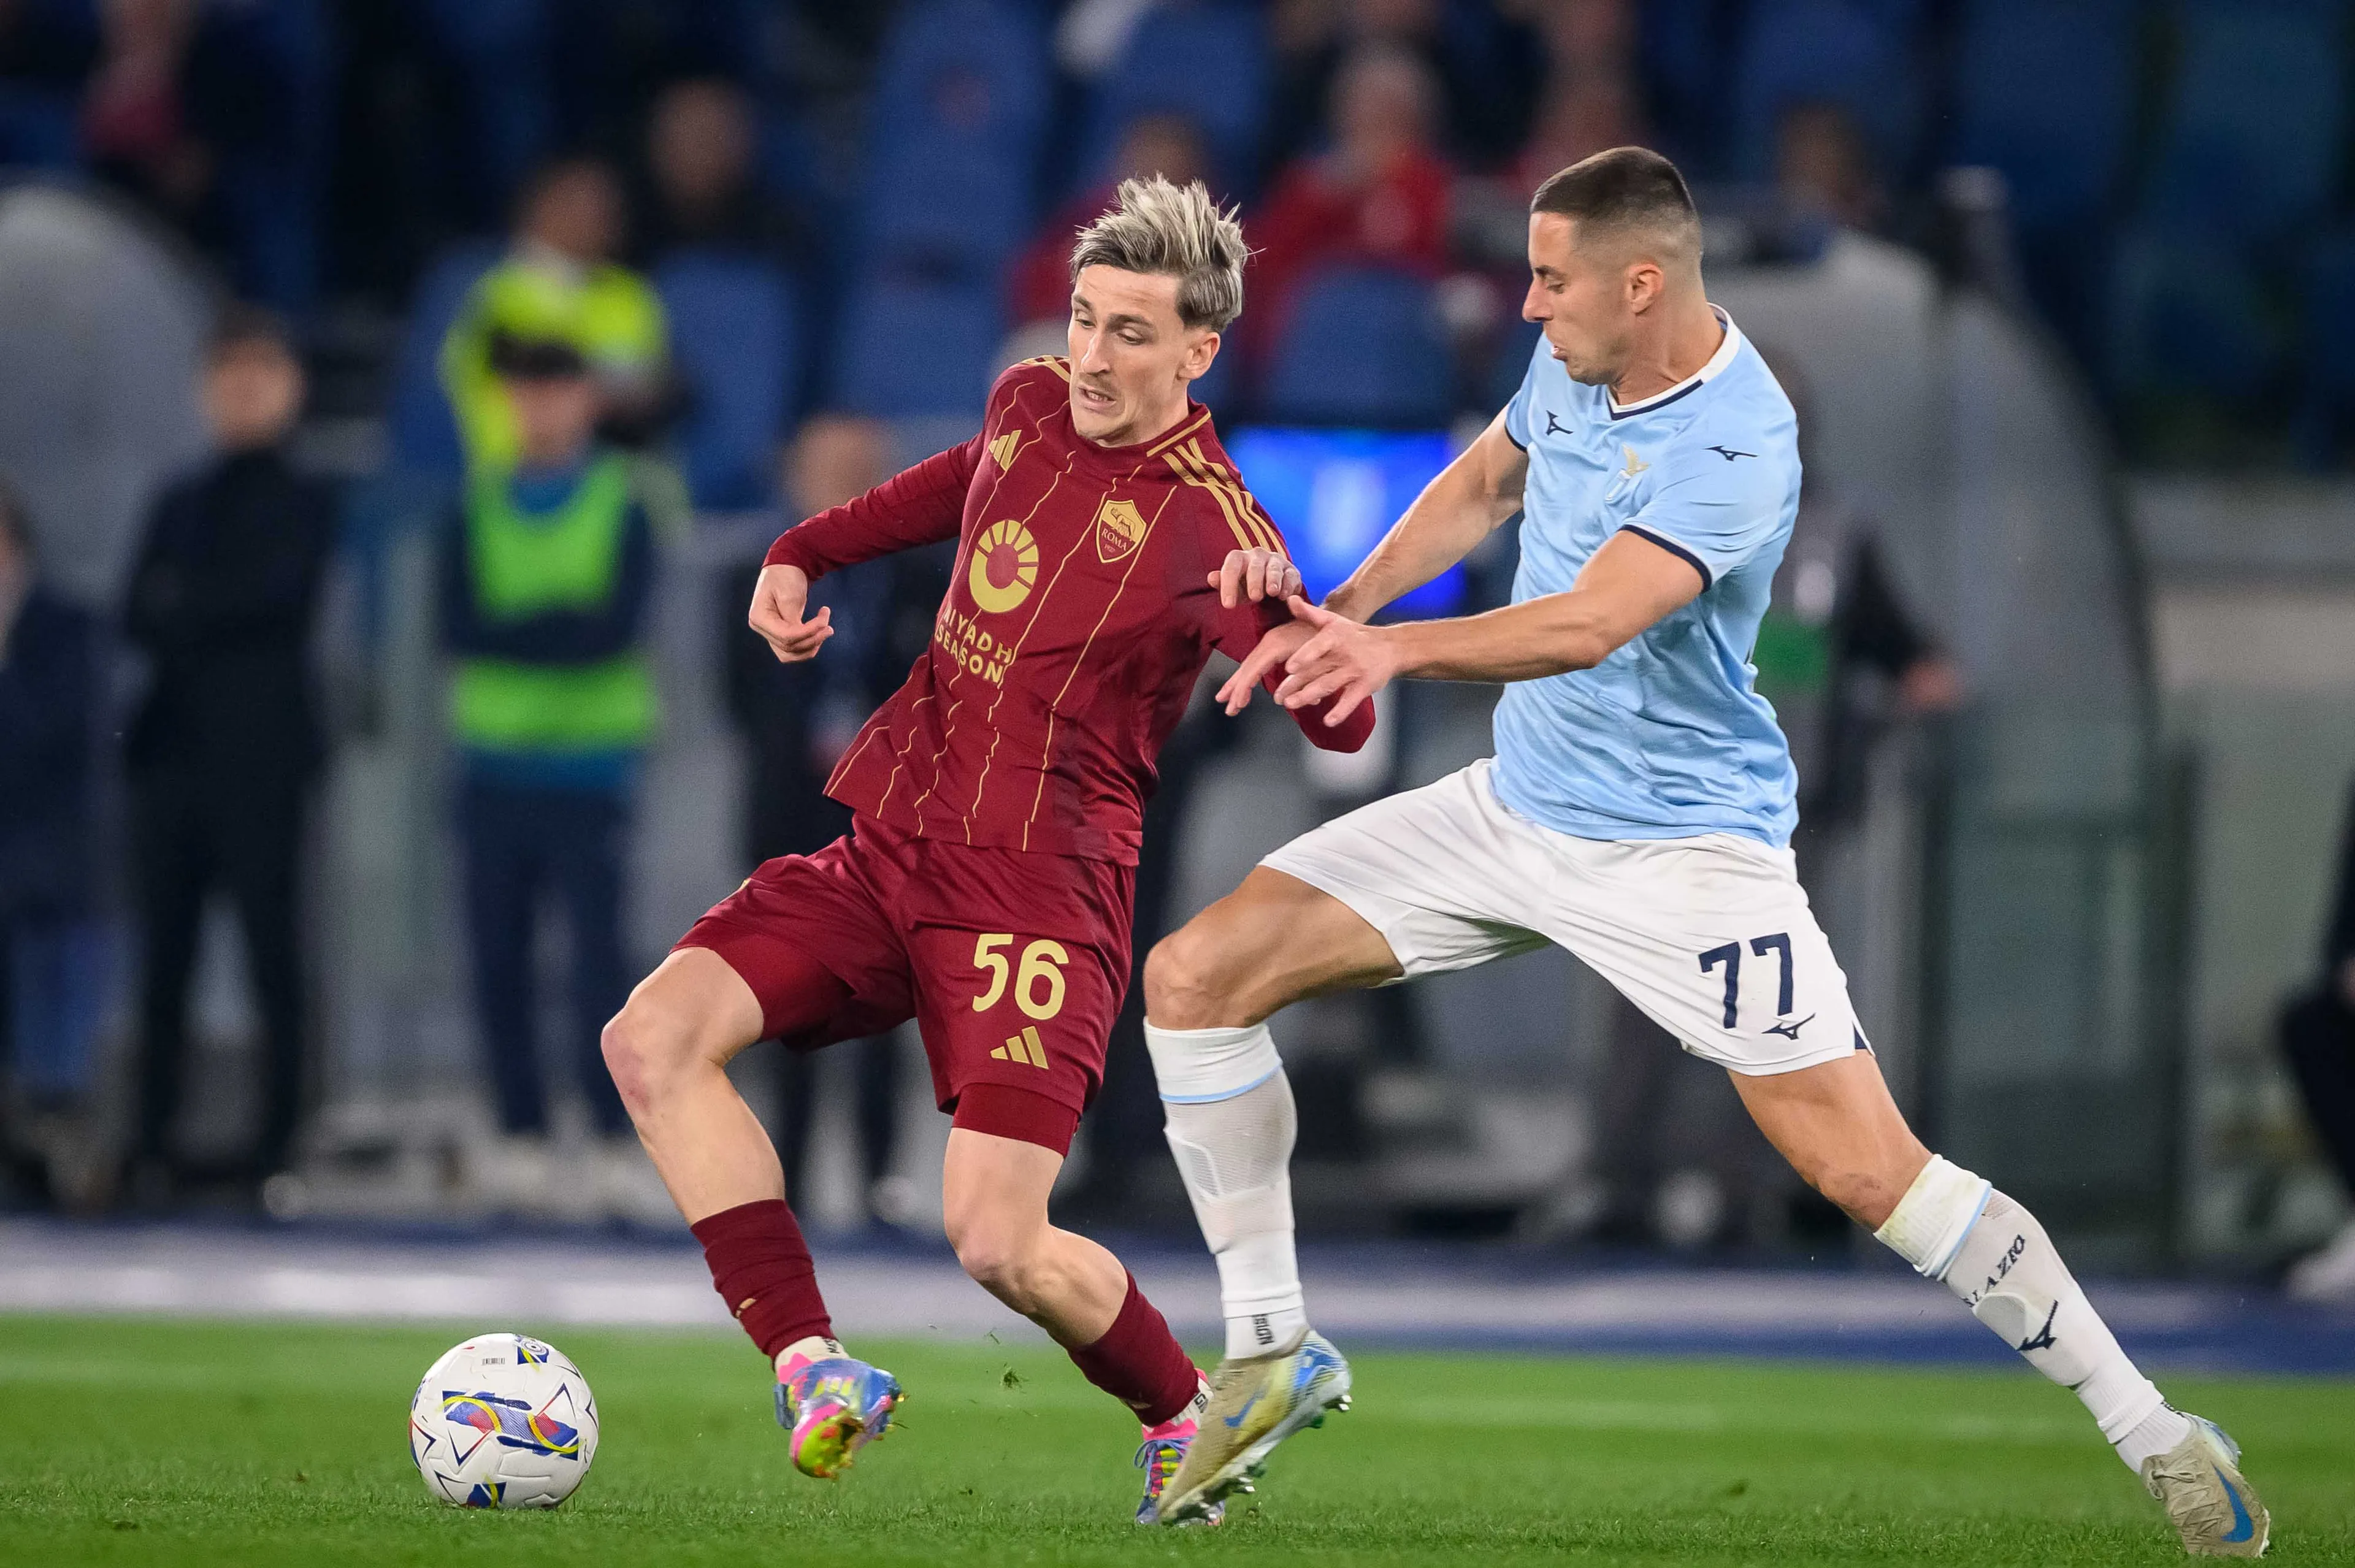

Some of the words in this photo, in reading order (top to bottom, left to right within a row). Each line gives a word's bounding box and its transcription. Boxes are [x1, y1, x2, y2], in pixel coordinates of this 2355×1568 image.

[1101, 528, 1127, 551] ROMA
[936, 624, 1003, 683] SEASON
[972, 933, 1069, 1020] 56
[1699, 932, 1793, 1029] 77
